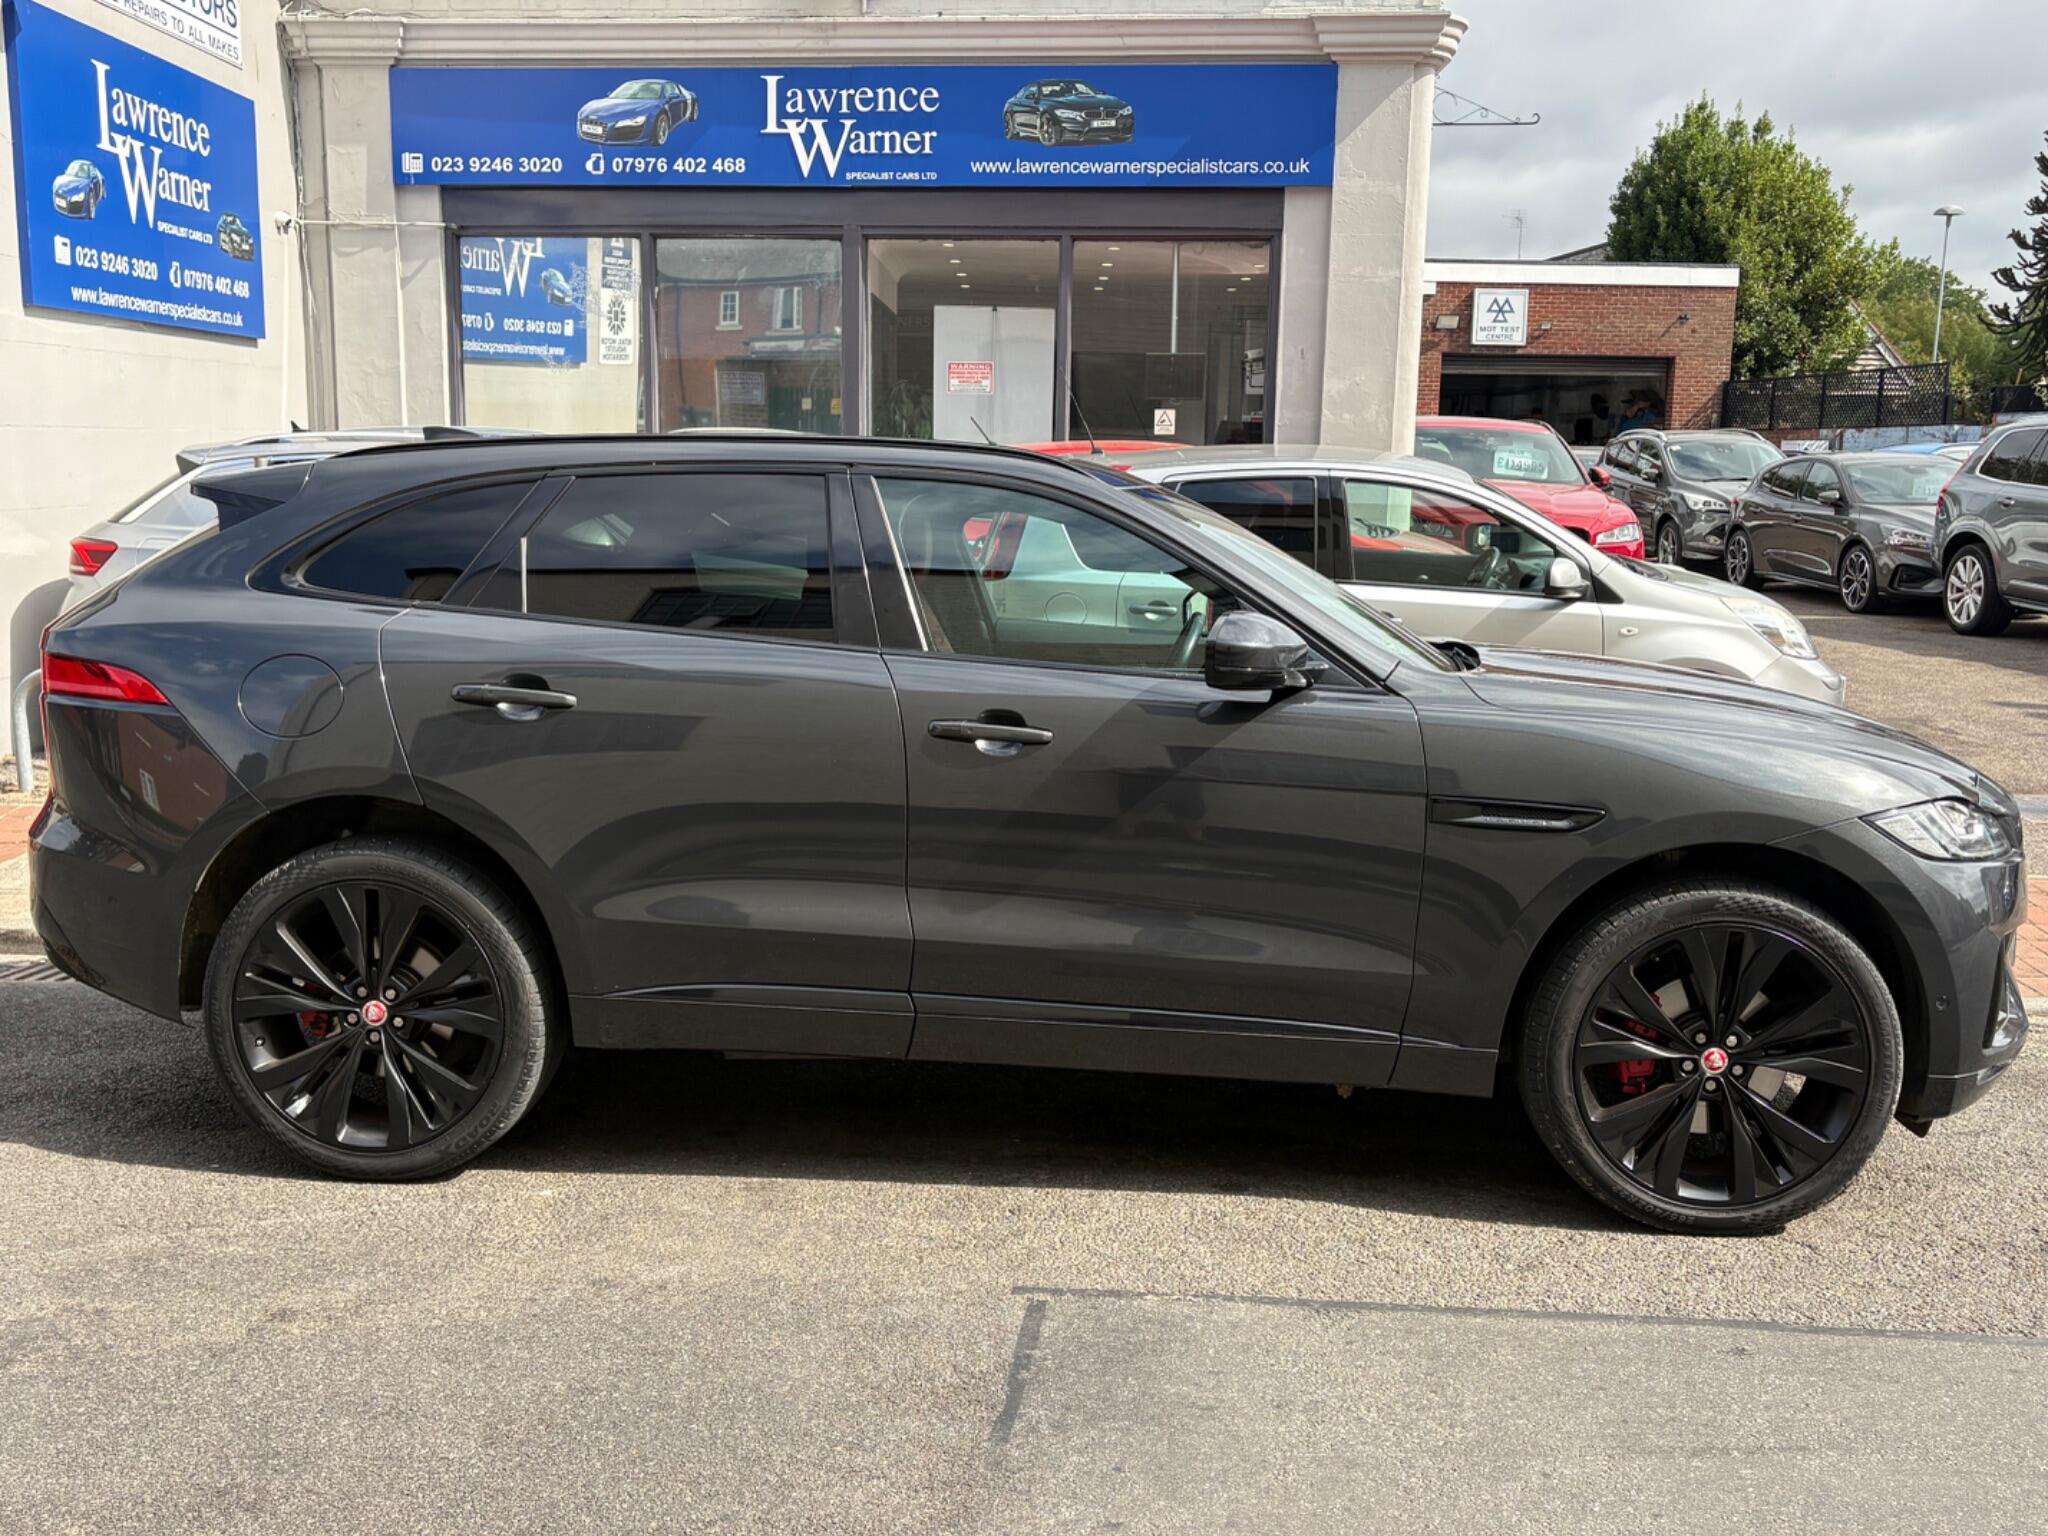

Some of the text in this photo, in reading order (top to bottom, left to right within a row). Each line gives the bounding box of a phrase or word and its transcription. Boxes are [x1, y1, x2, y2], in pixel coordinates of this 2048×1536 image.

[124, 0, 239, 60] REPAIRS TO ALL MAKES
[91, 59, 211, 157] Lawrence
[760, 75, 940, 134] Lawrence
[431, 157, 563, 172] 023 9246 3020
[612, 157, 746, 173] 07976 402 468
[781, 117, 938, 178] Warner
[970, 158, 1310, 176] www.lawrencewarnerspecialistcars.co.uk
[111, 132, 211, 229] Warner
[845, 172, 937, 180] SPECIALIST CARS LTD
[75, 245, 158, 281] 023 9246 3020
[184, 269, 250, 299] 07976 402 468
[71, 285, 243, 327] www.lawrencewarnerspecialistcars.co.uk
